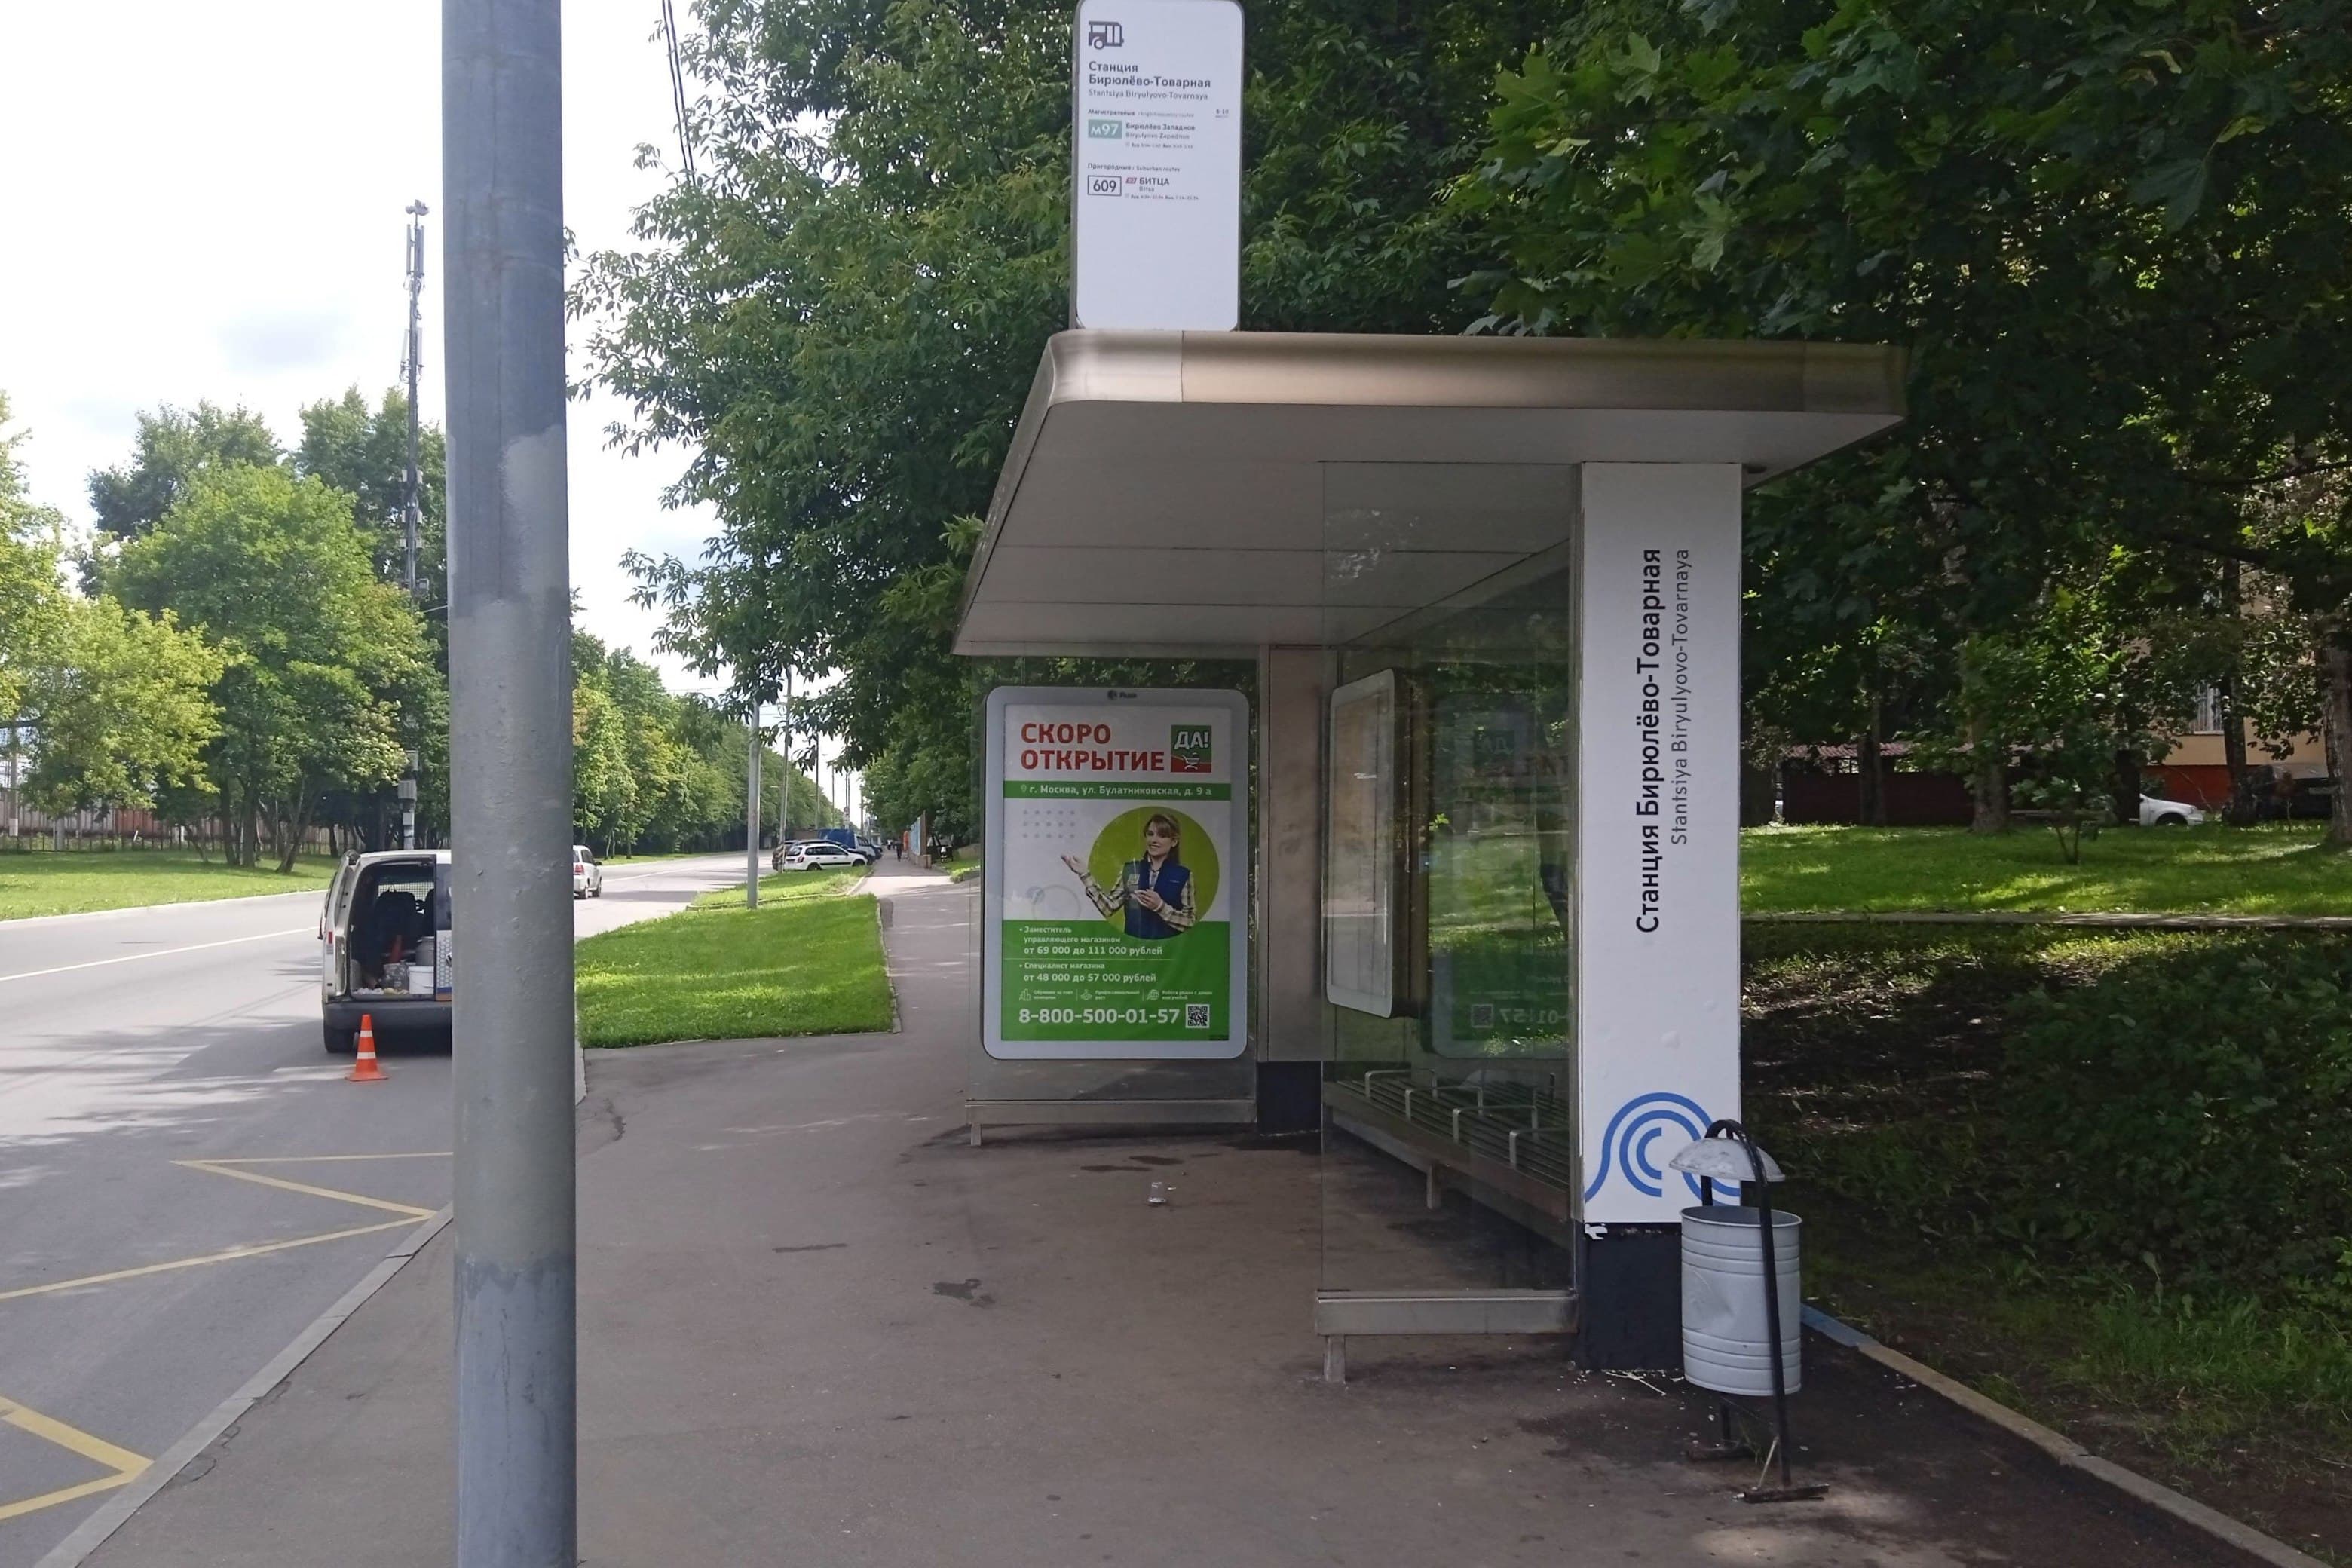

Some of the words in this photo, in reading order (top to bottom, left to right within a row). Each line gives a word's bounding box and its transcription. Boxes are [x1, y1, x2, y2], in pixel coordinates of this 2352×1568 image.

[1089, 60, 1138, 73] Станция
[1089, 74, 1211, 89] Бирюлёво-Товарная
[1088, 89, 1124, 98] Stantsiya
[1093, 179, 1117, 192] 609
[1139, 176, 1170, 186] БИТЦА
[1671, 549, 1692, 753] Biryulyovo-Tovarnaya
[1635, 549, 1666, 816] Бирюлёво-Товарная
[1021, 722, 1111, 744] СКОРО
[1174, 730, 1210, 749] ДА!
[1021, 749, 1165, 771] ОТКРЫТИЕ
[1040, 785, 1079, 795] Москва,
[1082, 787, 1096, 796] ул.
[1671, 758, 1692, 845] Stantsiya
[1635, 825, 1663, 933] Станция
[1037, 946, 1049, 954] 69
[1052, 946, 1070, 954] 000
[1088, 946, 1105, 954] 111
[1108, 946, 1127, 955] 000
[1129, 946, 1162, 956] рублей
[1037, 973, 1049, 982] 48
[1052, 973, 1070, 982] 000
[1087, 973, 1099, 982] 57
[1102, 973, 1121, 982] 000
[1123, 973, 1157, 983] рублей
[1019, 1008, 1181, 1024] 8-800-500-01-57
